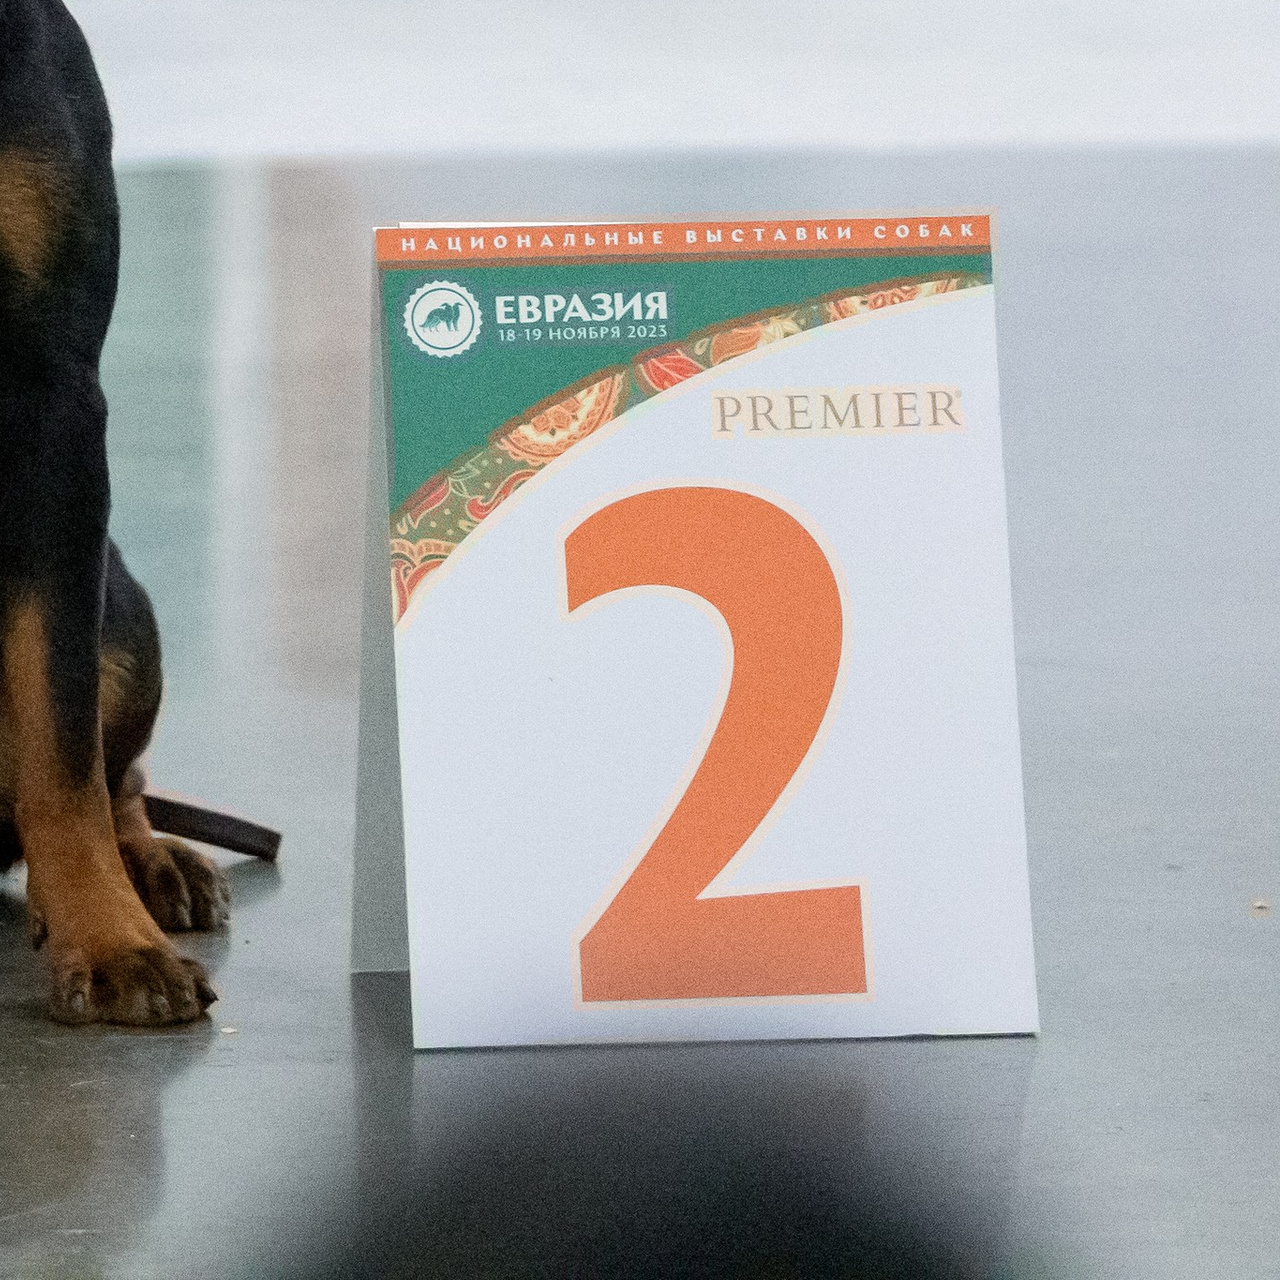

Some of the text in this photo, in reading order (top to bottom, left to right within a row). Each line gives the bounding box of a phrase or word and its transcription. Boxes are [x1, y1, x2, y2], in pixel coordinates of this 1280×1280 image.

[400, 222, 975, 253] НАЦИОНАЛЬНЫЕ ВЫСТАВКИ СОБАК
[494, 291, 669, 325] ЕВРАЗИЯ
[548, 325, 622, 341] НОЯБРЯ
[627, 323, 668, 339] 2023
[714, 389, 963, 433] PREMIER
[563, 485, 868, 1003] 2
